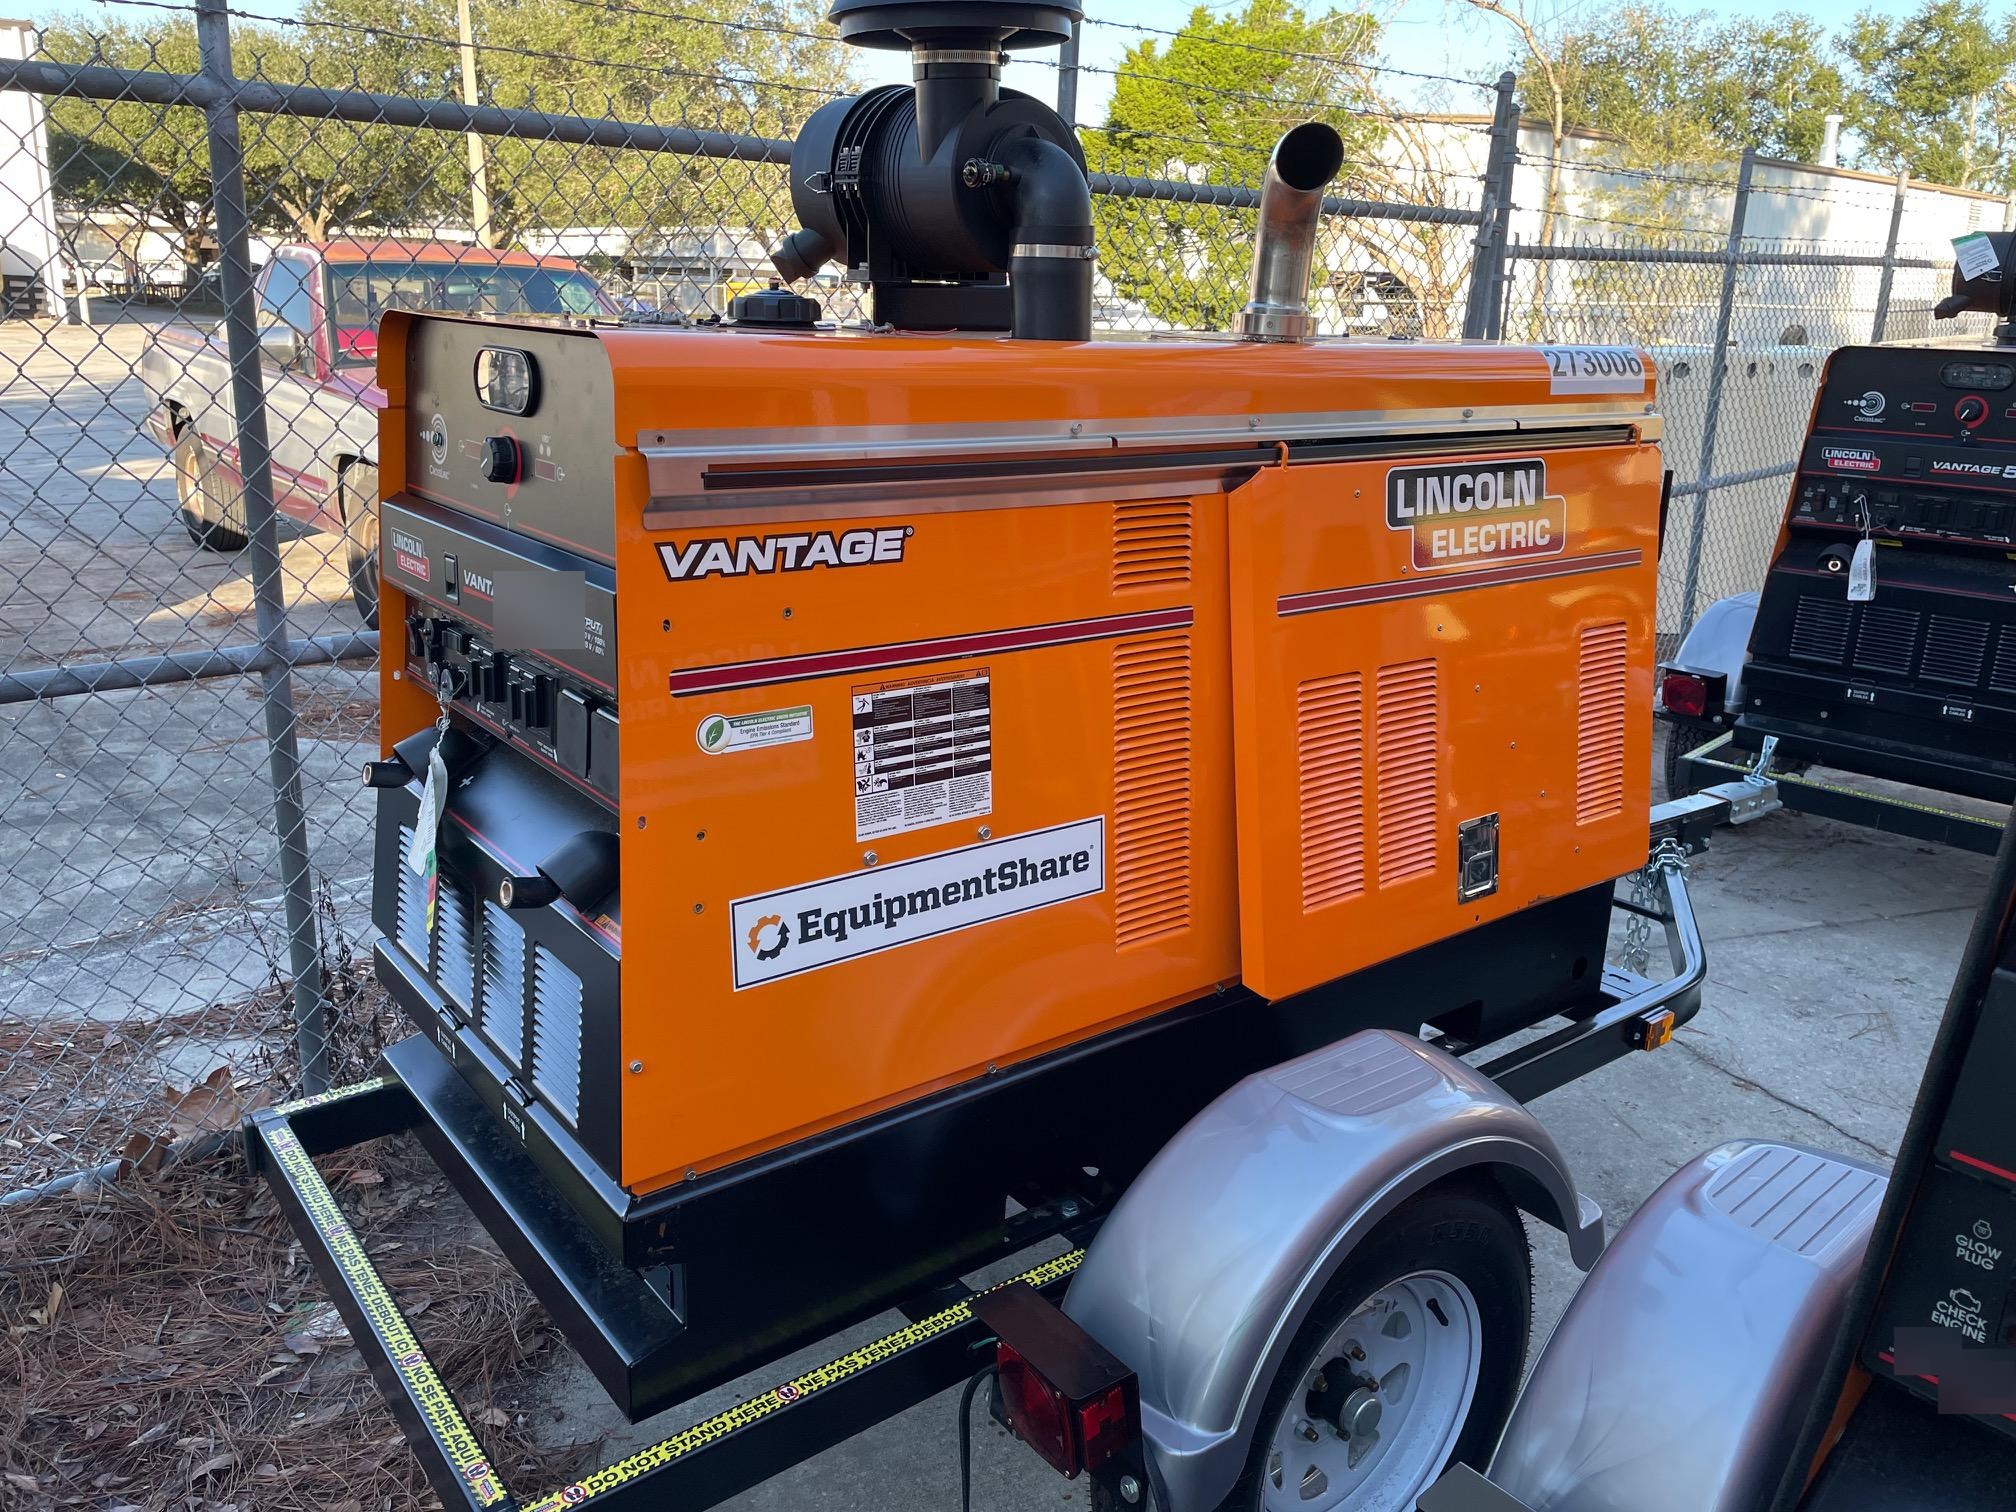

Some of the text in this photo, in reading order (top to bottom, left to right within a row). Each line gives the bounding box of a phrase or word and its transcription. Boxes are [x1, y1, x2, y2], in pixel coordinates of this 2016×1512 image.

[1543, 350, 1642, 376] 273006
[1824, 449, 1871, 460] LINCOLN
[1834, 459, 1874, 469] ELECTRIC
[1932, 461, 2002, 475] VANTAGE
[1396, 469, 1536, 518] LINCOLN
[392, 531, 422, 559] LINCOLN
[1432, 518, 1550, 559] ELECTRIC
[400, 555, 426, 577] ELECTRIC
[658, 528, 905, 580] VANTAGE
[463, 569, 493, 596] VANT
[740, 720, 800, 735] Engine Emissions Standard
[797, 849, 1090, 945] EquipmentShare
[285, 1149, 338, 1227] DO NOT STAND HERE
[1955, 1234, 2002, 1261] GLOW
[1956, 1249, 1994, 1270] PLUG
[1036, 1267, 1056, 1279] SE
[1055, 1252, 1085, 1270] PAR
[336, 1235, 412, 1354] NE PAS TENEZ DEBOUT ICI
[1936, 1300, 1988, 1330] CHECK
[799, 1307, 966, 1391] NE PAS TENEZ DEBOU
[411, 1365, 430, 1385] NO
[421, 1383, 440, 1402] SE
[431, 1400, 459, 1434] PARE
[587, 1397, 779, 1491] DO NOT STAND HERE
